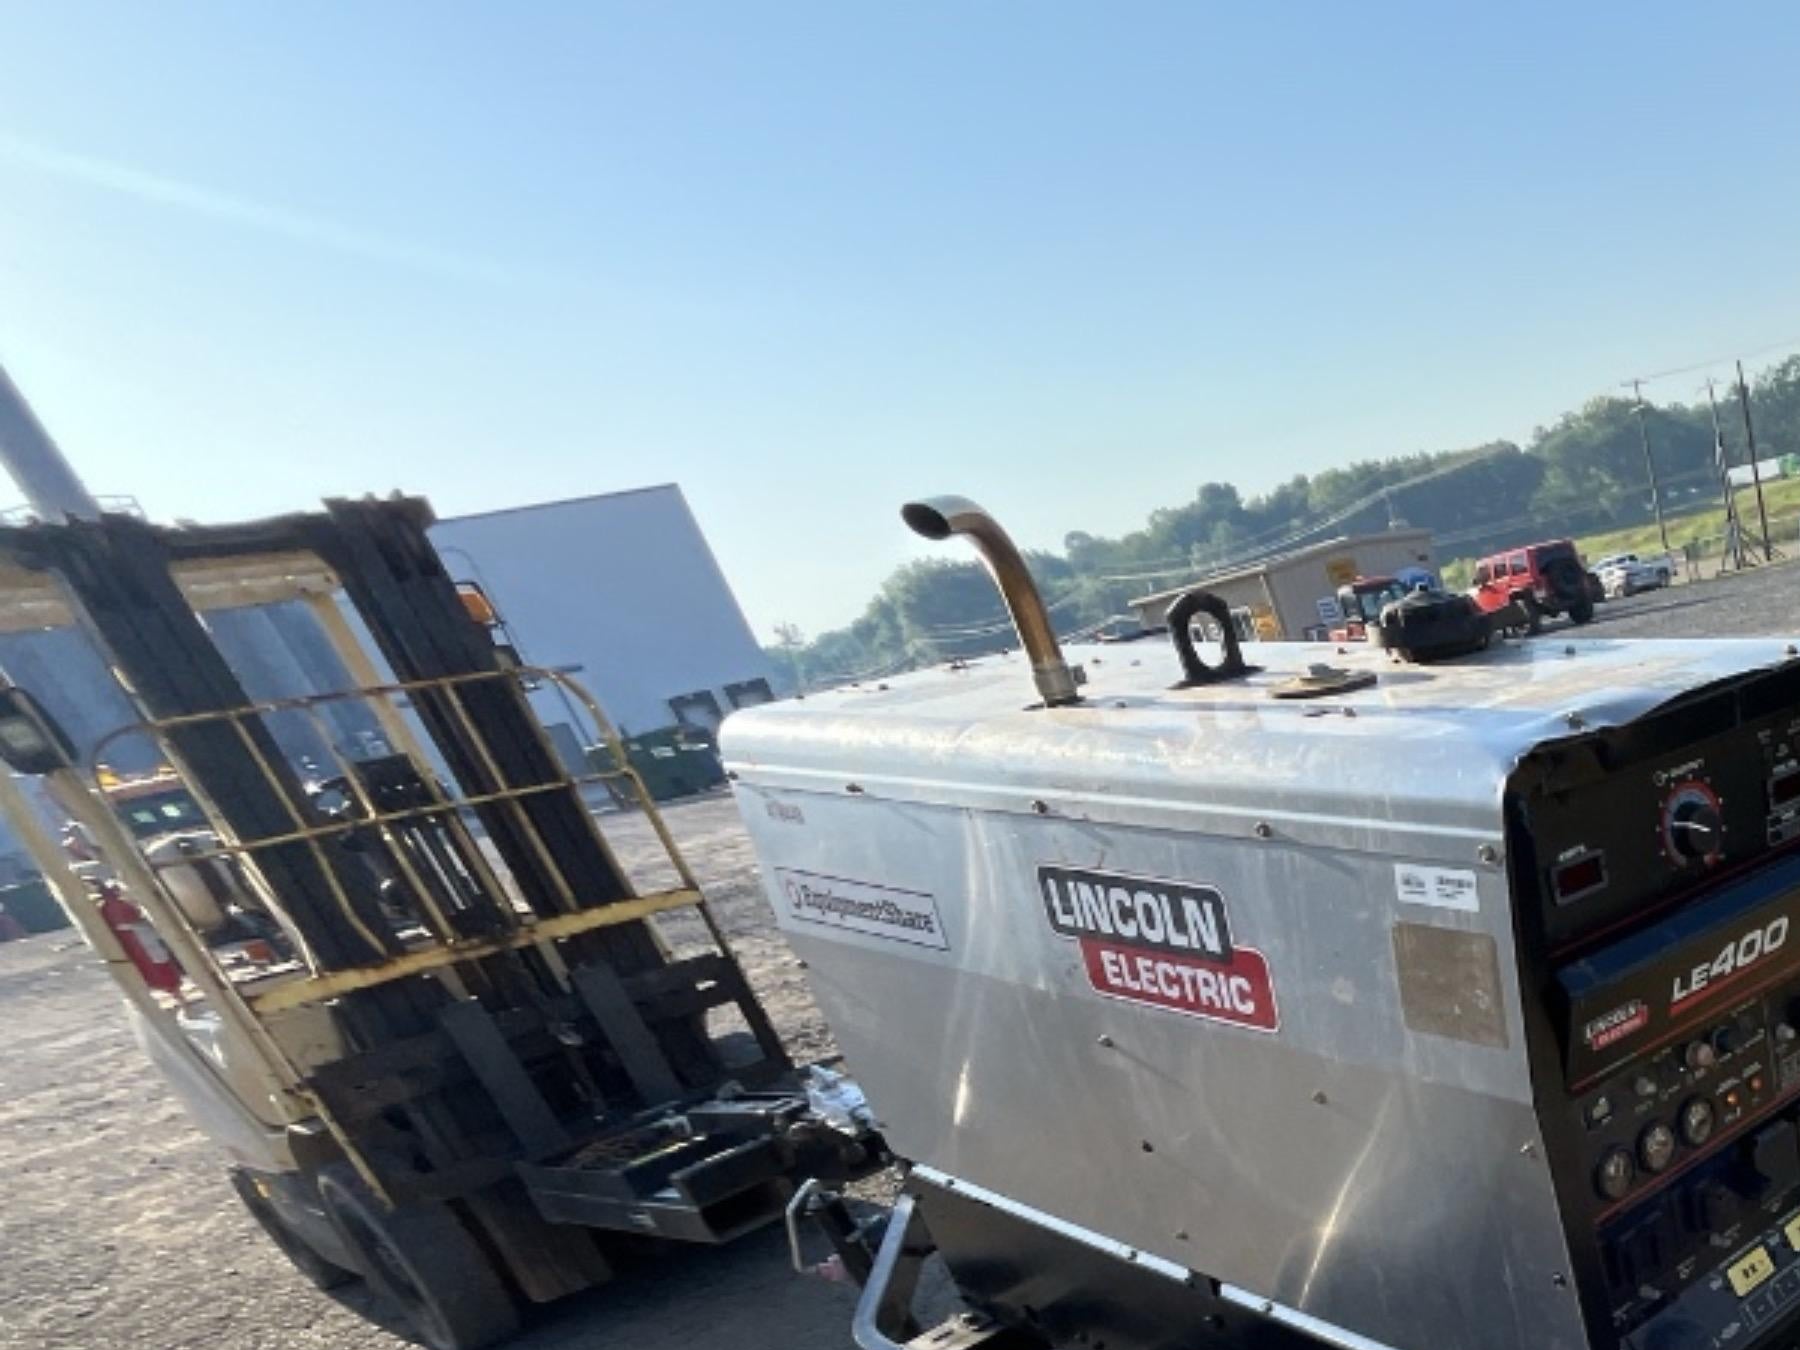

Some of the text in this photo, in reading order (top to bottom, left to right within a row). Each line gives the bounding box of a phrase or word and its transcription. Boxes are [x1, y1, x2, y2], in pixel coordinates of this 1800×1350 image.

[1047, 877, 1222, 955] LINCOLN
[1100, 949, 1256, 1015] ELECTRIC
[1672, 914, 1790, 1002] LE400
